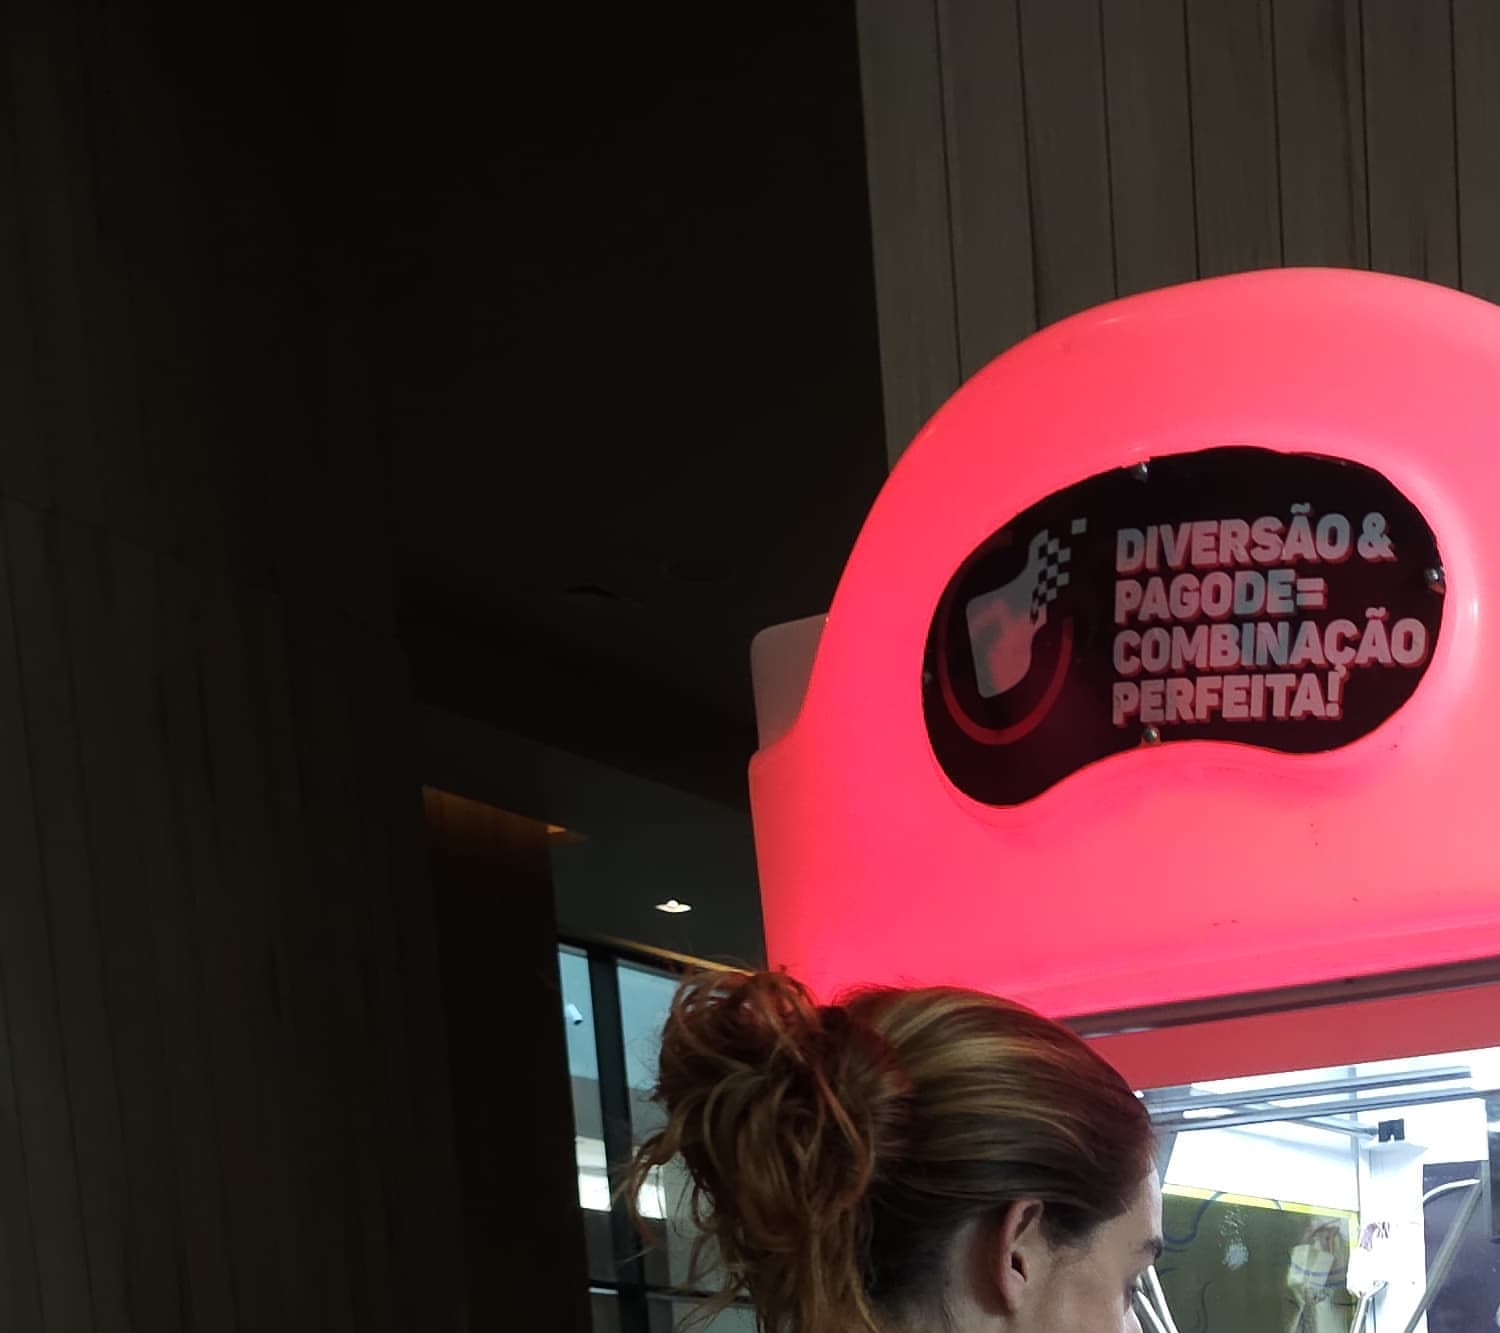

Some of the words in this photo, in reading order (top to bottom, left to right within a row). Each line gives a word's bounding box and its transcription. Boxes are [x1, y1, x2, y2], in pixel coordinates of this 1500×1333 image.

[1115, 503, 1349, 573] DIVERSÃO
[1357, 511, 1397, 562] &
[1112, 607, 1430, 678] COMBINAÇÃO
[1112, 670, 1345, 726] PERFEITA!
